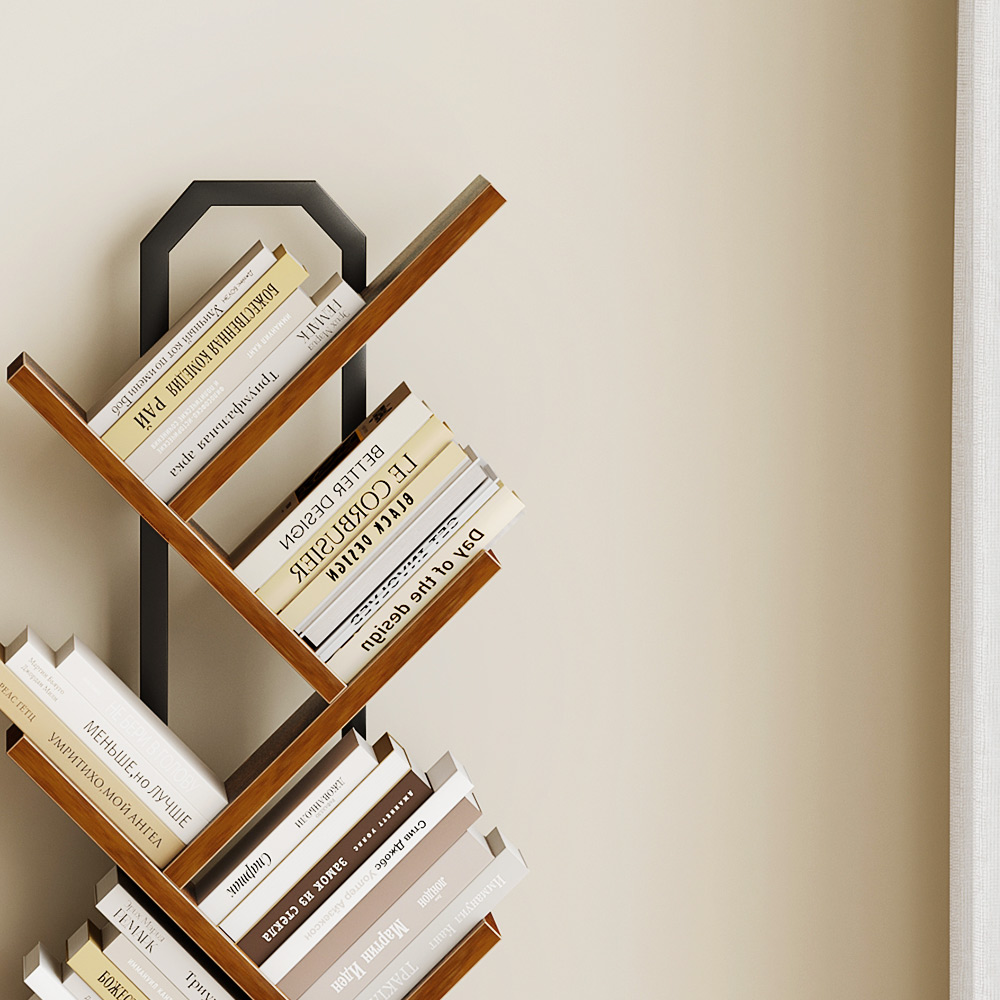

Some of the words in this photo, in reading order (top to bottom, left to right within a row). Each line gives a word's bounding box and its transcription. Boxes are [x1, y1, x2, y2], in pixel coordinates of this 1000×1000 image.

[181, 304, 223, 344] Уличный
[206, 282, 279, 355] БОЖЕСТВЕННАЯ
[260, 312, 291, 344] ИММАНУИЛ
[296, 298, 341, 343] РЕМАРК
[154, 356, 167, 369] по
[167, 341, 183, 358] кот
[246, 342, 262, 358] КАНТ
[127, 368, 156, 396] имени
[165, 349, 212, 396] КОМЕДИЯ
[111, 395, 132, 416] Боб
[133, 395, 166, 430] РАЙ
[196, 371, 279, 449] Триумфальная
[169, 450, 194, 476] арка
[146, 785, 192, 828] ЛУЧШЕ
[127, 813, 162, 848] АНГЕЛ
[403, 820, 426, 841] Стив
[374, 838, 404, 870] Джобс
[226, 852, 271, 897] Спартак
[343, 869, 377, 900] Уолтер
[298, 890, 314, 906] из
[416, 876, 447, 908] ЛОНДОН
[454, 873, 506, 923] Иммануил
[113, 908, 154, 953] РЕМАРК
[261, 905, 298, 941] стекла
[303, 898, 345, 940] Айзексон
[360, 918, 409, 963] Мартин
[428, 923, 456, 950] Кант
[127, 958, 158, 989] ИММАНУИЛ
[330, 960, 366, 993] Иден
